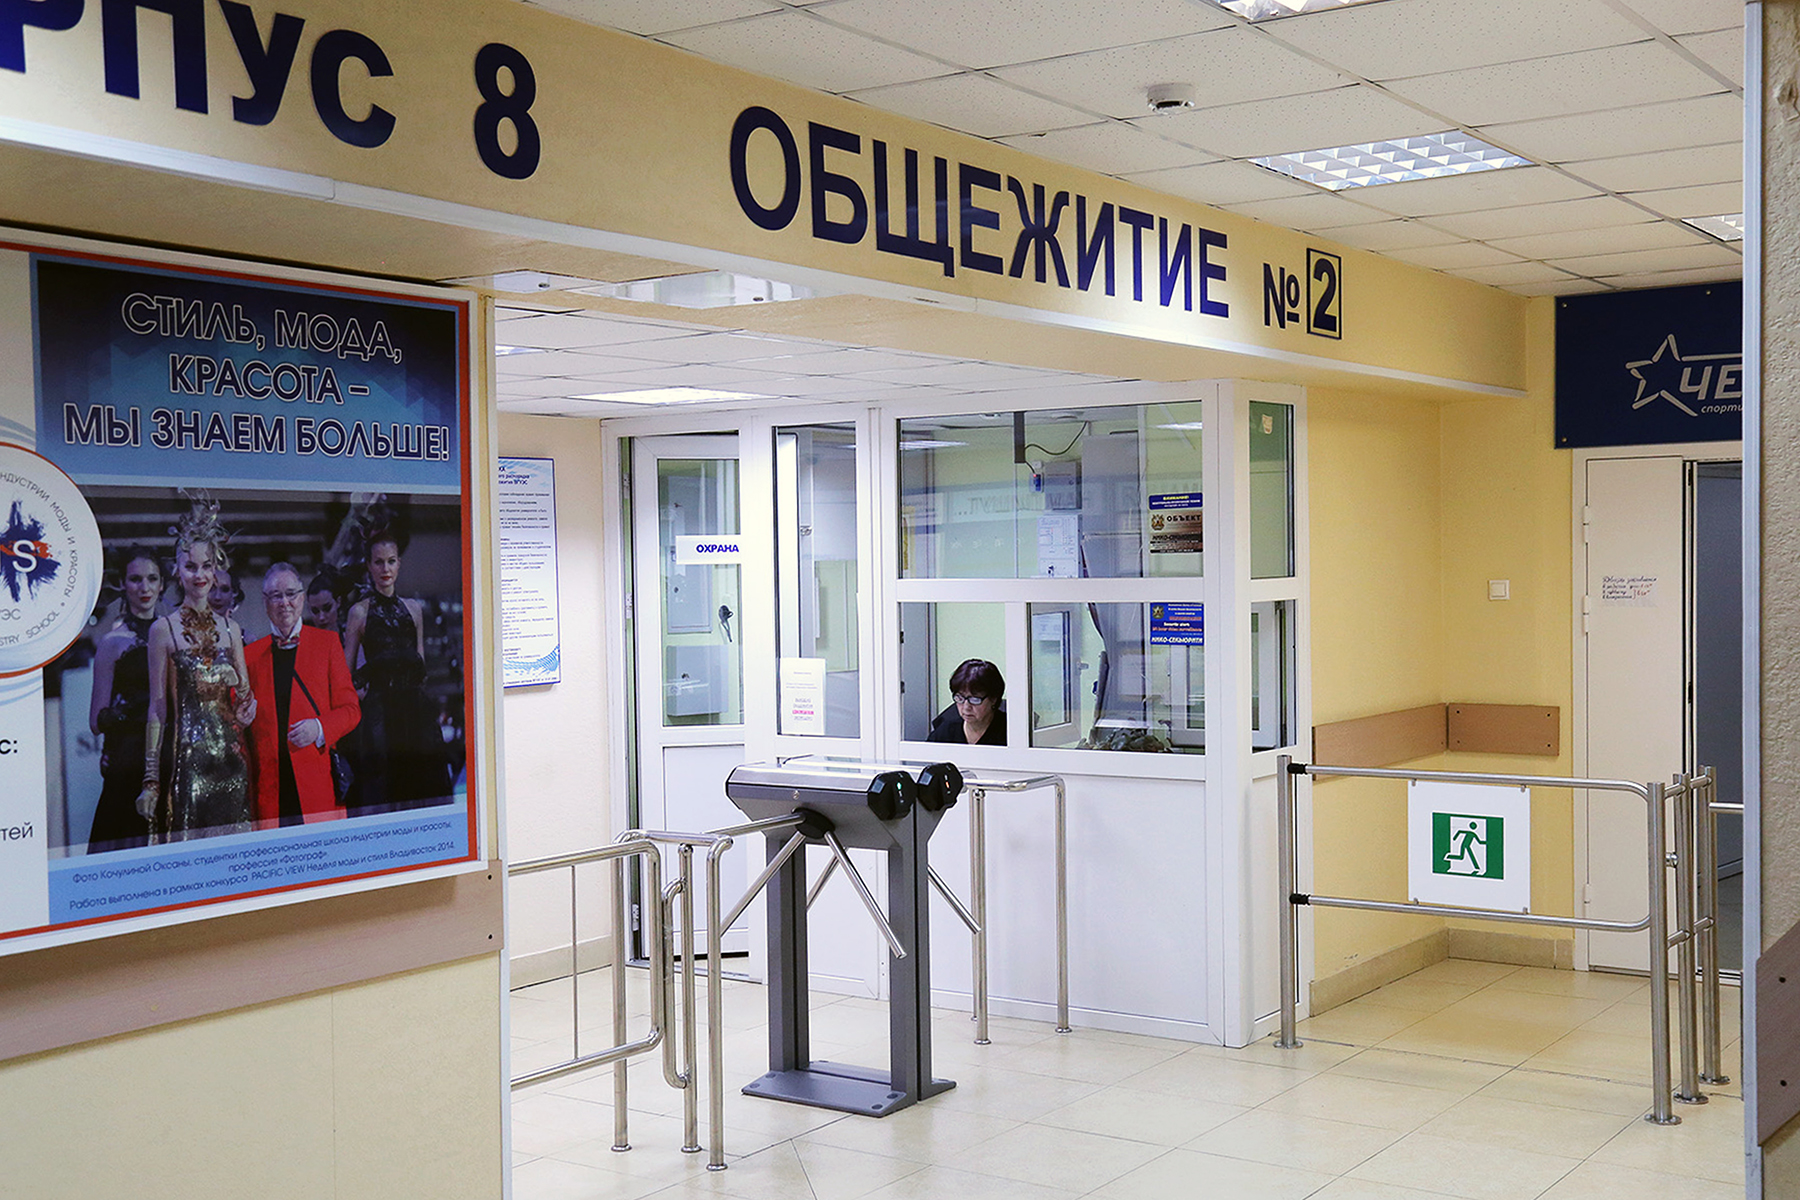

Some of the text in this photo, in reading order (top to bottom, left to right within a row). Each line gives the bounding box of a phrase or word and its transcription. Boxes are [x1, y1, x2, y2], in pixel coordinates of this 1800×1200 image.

[474, 42, 541, 180] 8
[729, 106, 1230, 319] ОБЩЕЖИТИЕ
[121, 293, 402, 363] СТИЛЬ, МОДА,
[169, 354, 344, 404] КРАСОТА
[63, 403, 450, 461] МЫ ЗНАЕМ БОЛЬШЕ!
[1166, 514, 1201, 522] ОБЪЕКТ
[12, 539, 38, 573] S
[50, 501, 70, 532] МОДЫ
[64, 550, 78, 598] КРАСОТЫ
[696, 543, 740, 553] ОХРАНА
[26, 610, 60, 639] SCHOOL
[69, 897, 107, 911] Работа
[285, 864, 306, 876] VIEW
[73, 872, 99, 884] Фото
